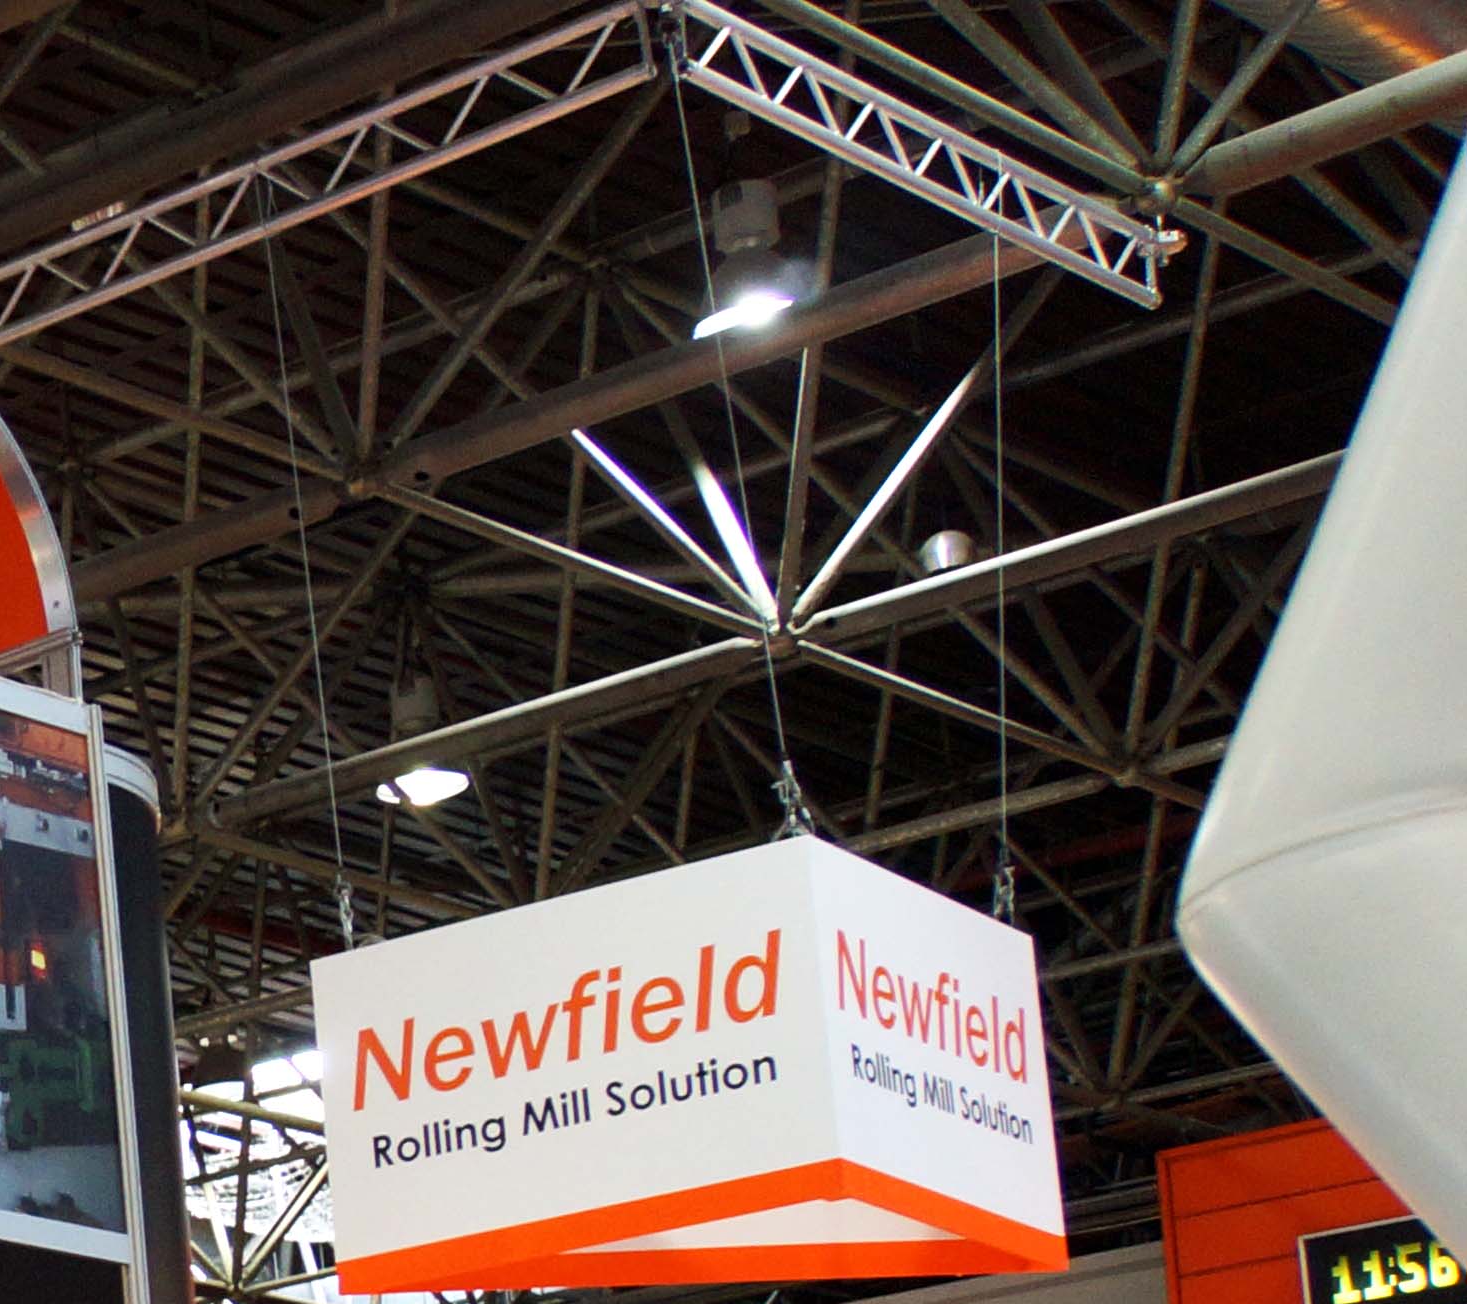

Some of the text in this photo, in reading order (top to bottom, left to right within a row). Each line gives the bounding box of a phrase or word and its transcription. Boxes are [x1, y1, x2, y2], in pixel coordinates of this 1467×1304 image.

[354, 928, 783, 1112] Newfield
[836, 928, 1029, 1086] Newfield
[373, 1051, 778, 1169] Rolling Mill Solution
[851, 1045, 1035, 1147] Rolling Mill Solution
